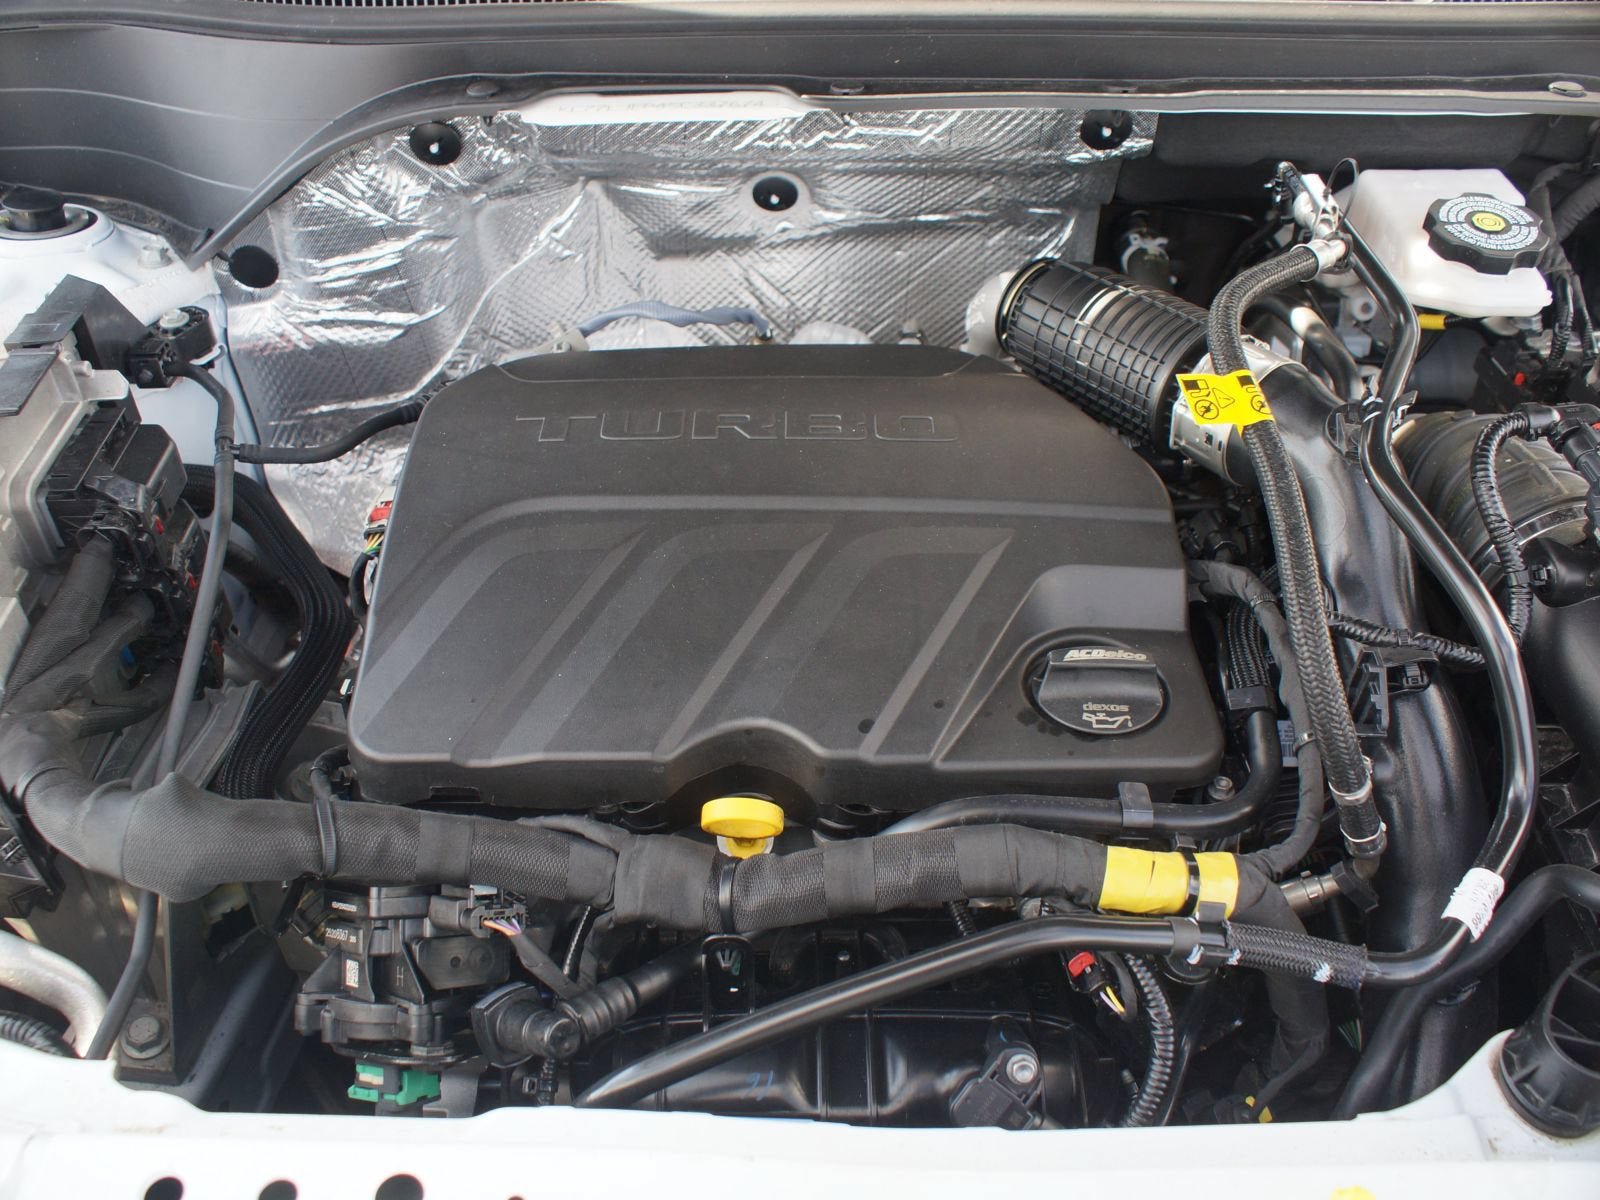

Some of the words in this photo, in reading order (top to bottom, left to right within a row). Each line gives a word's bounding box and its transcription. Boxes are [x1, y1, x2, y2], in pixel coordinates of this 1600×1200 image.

[516, 410, 957, 442] TURBO
[1063, 649, 1147, 661] ACDelco
[1082, 702, 1130, 712] dexos
